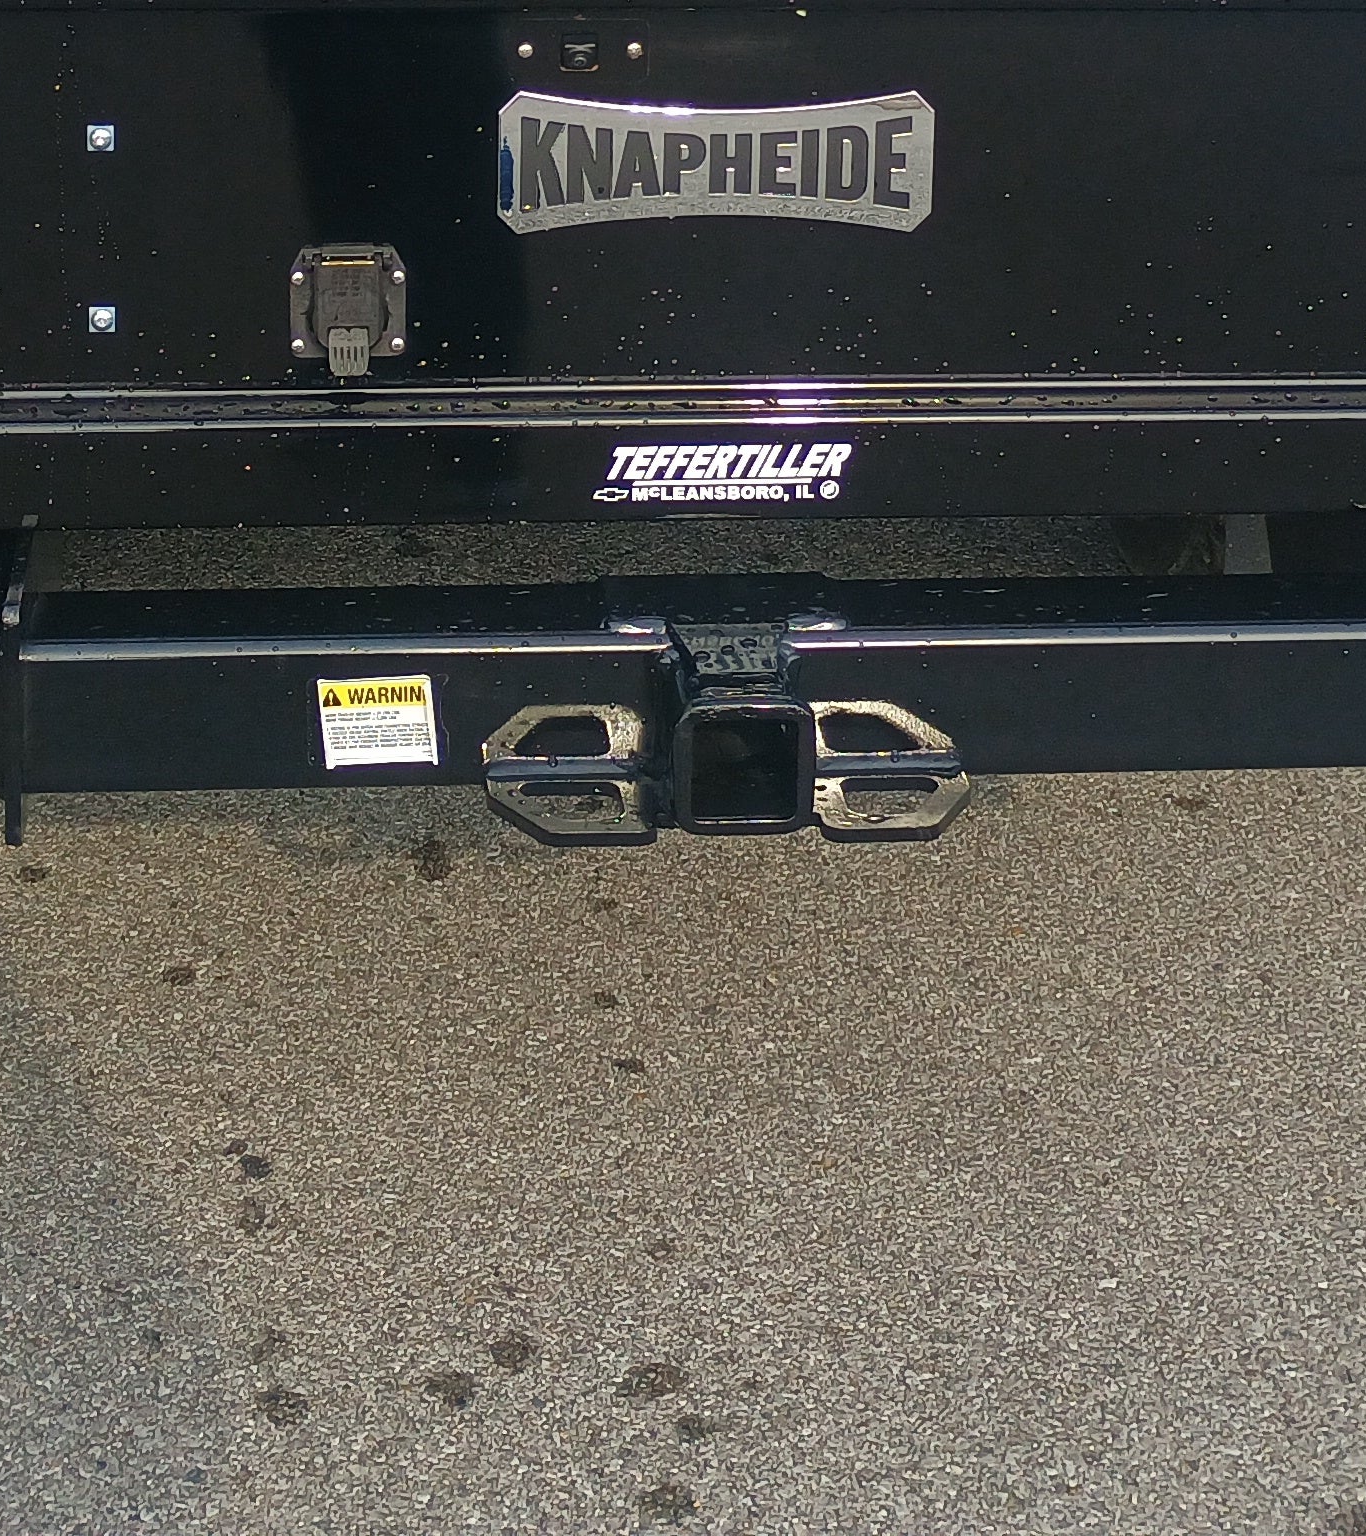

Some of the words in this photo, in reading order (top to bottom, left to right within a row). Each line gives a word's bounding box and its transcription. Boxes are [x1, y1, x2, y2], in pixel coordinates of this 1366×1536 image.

[519, 115, 914, 213] KNAPHEIDE
[606, 443, 853, 480] TEFFERTILLER
[795, 484, 815, 500] IL
[347, 685, 426, 705] WARNIN
